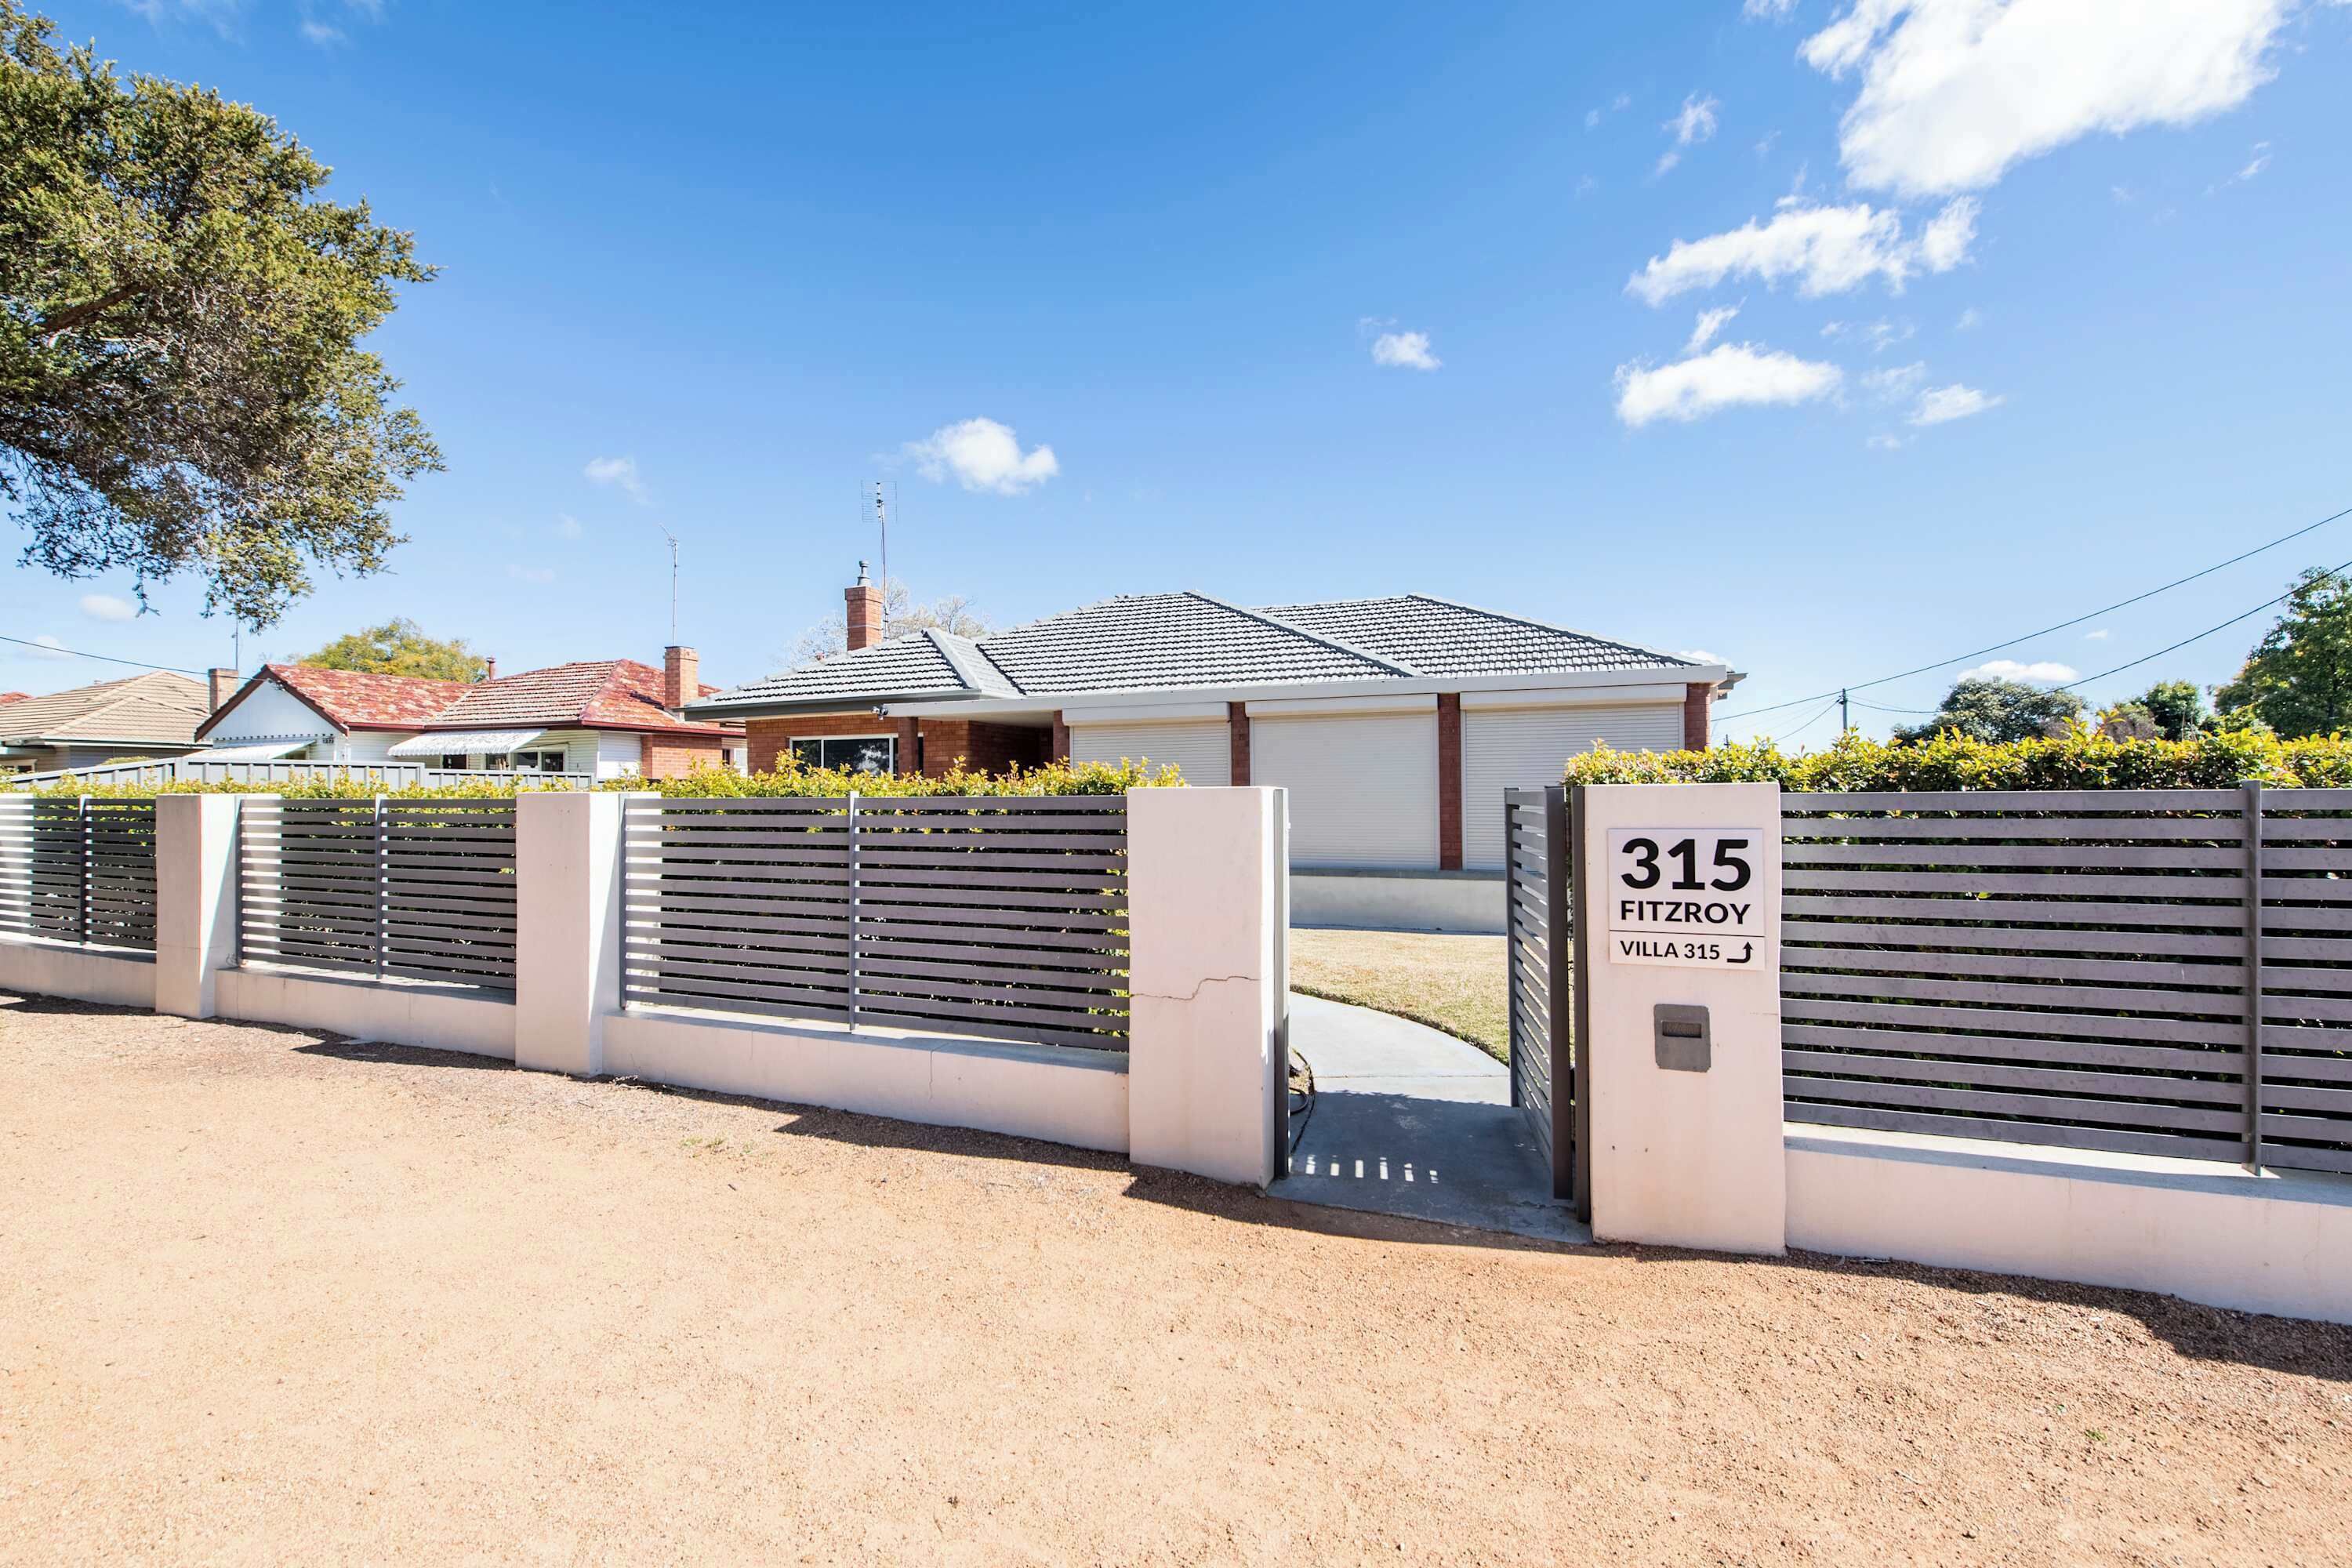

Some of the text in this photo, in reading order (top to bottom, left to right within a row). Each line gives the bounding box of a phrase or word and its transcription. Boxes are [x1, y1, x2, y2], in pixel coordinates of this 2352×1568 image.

[1621, 837, 1751, 891] 315
[1621, 900, 1751, 924] FITZROY
[1620, 940, 1720, 960] VILLA 315
